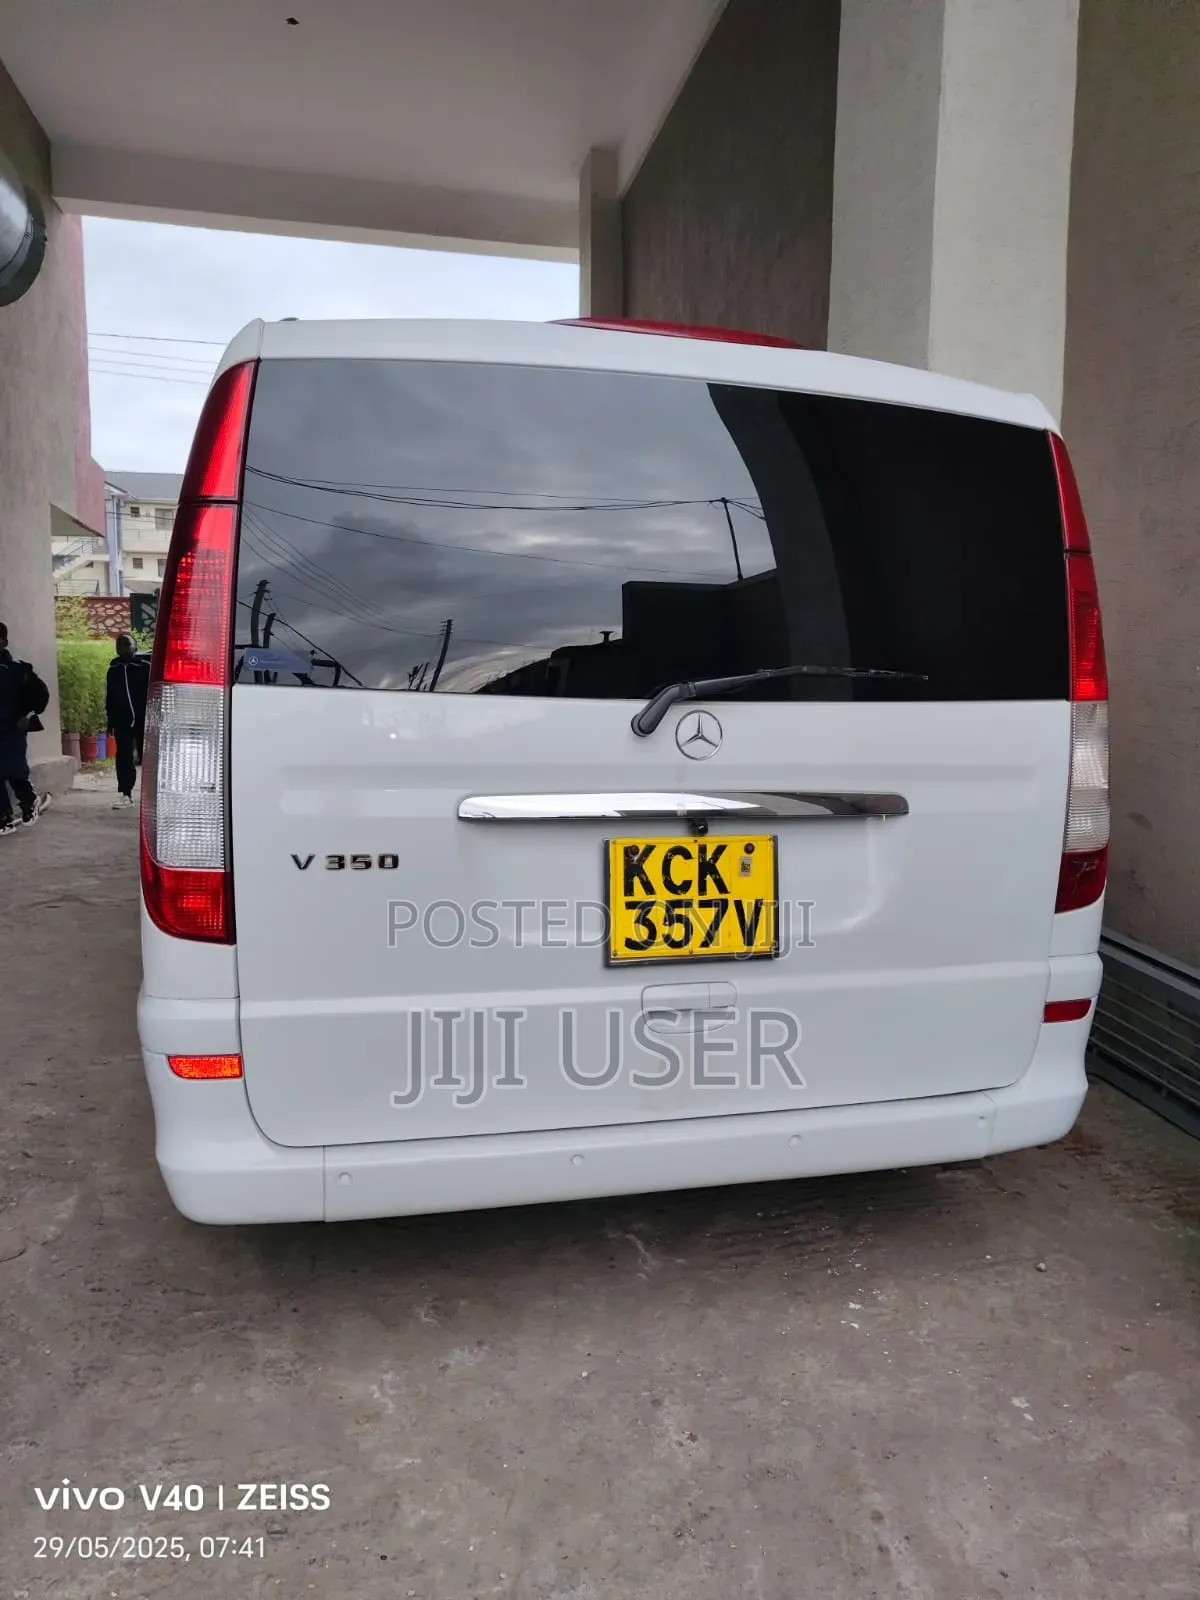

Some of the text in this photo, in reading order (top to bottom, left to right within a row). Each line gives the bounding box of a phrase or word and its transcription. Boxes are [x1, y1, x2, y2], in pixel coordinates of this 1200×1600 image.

[290, 853, 399, 870] V 350
[623, 844, 730, 897] KCK
[624, 898, 764, 951] 357V
